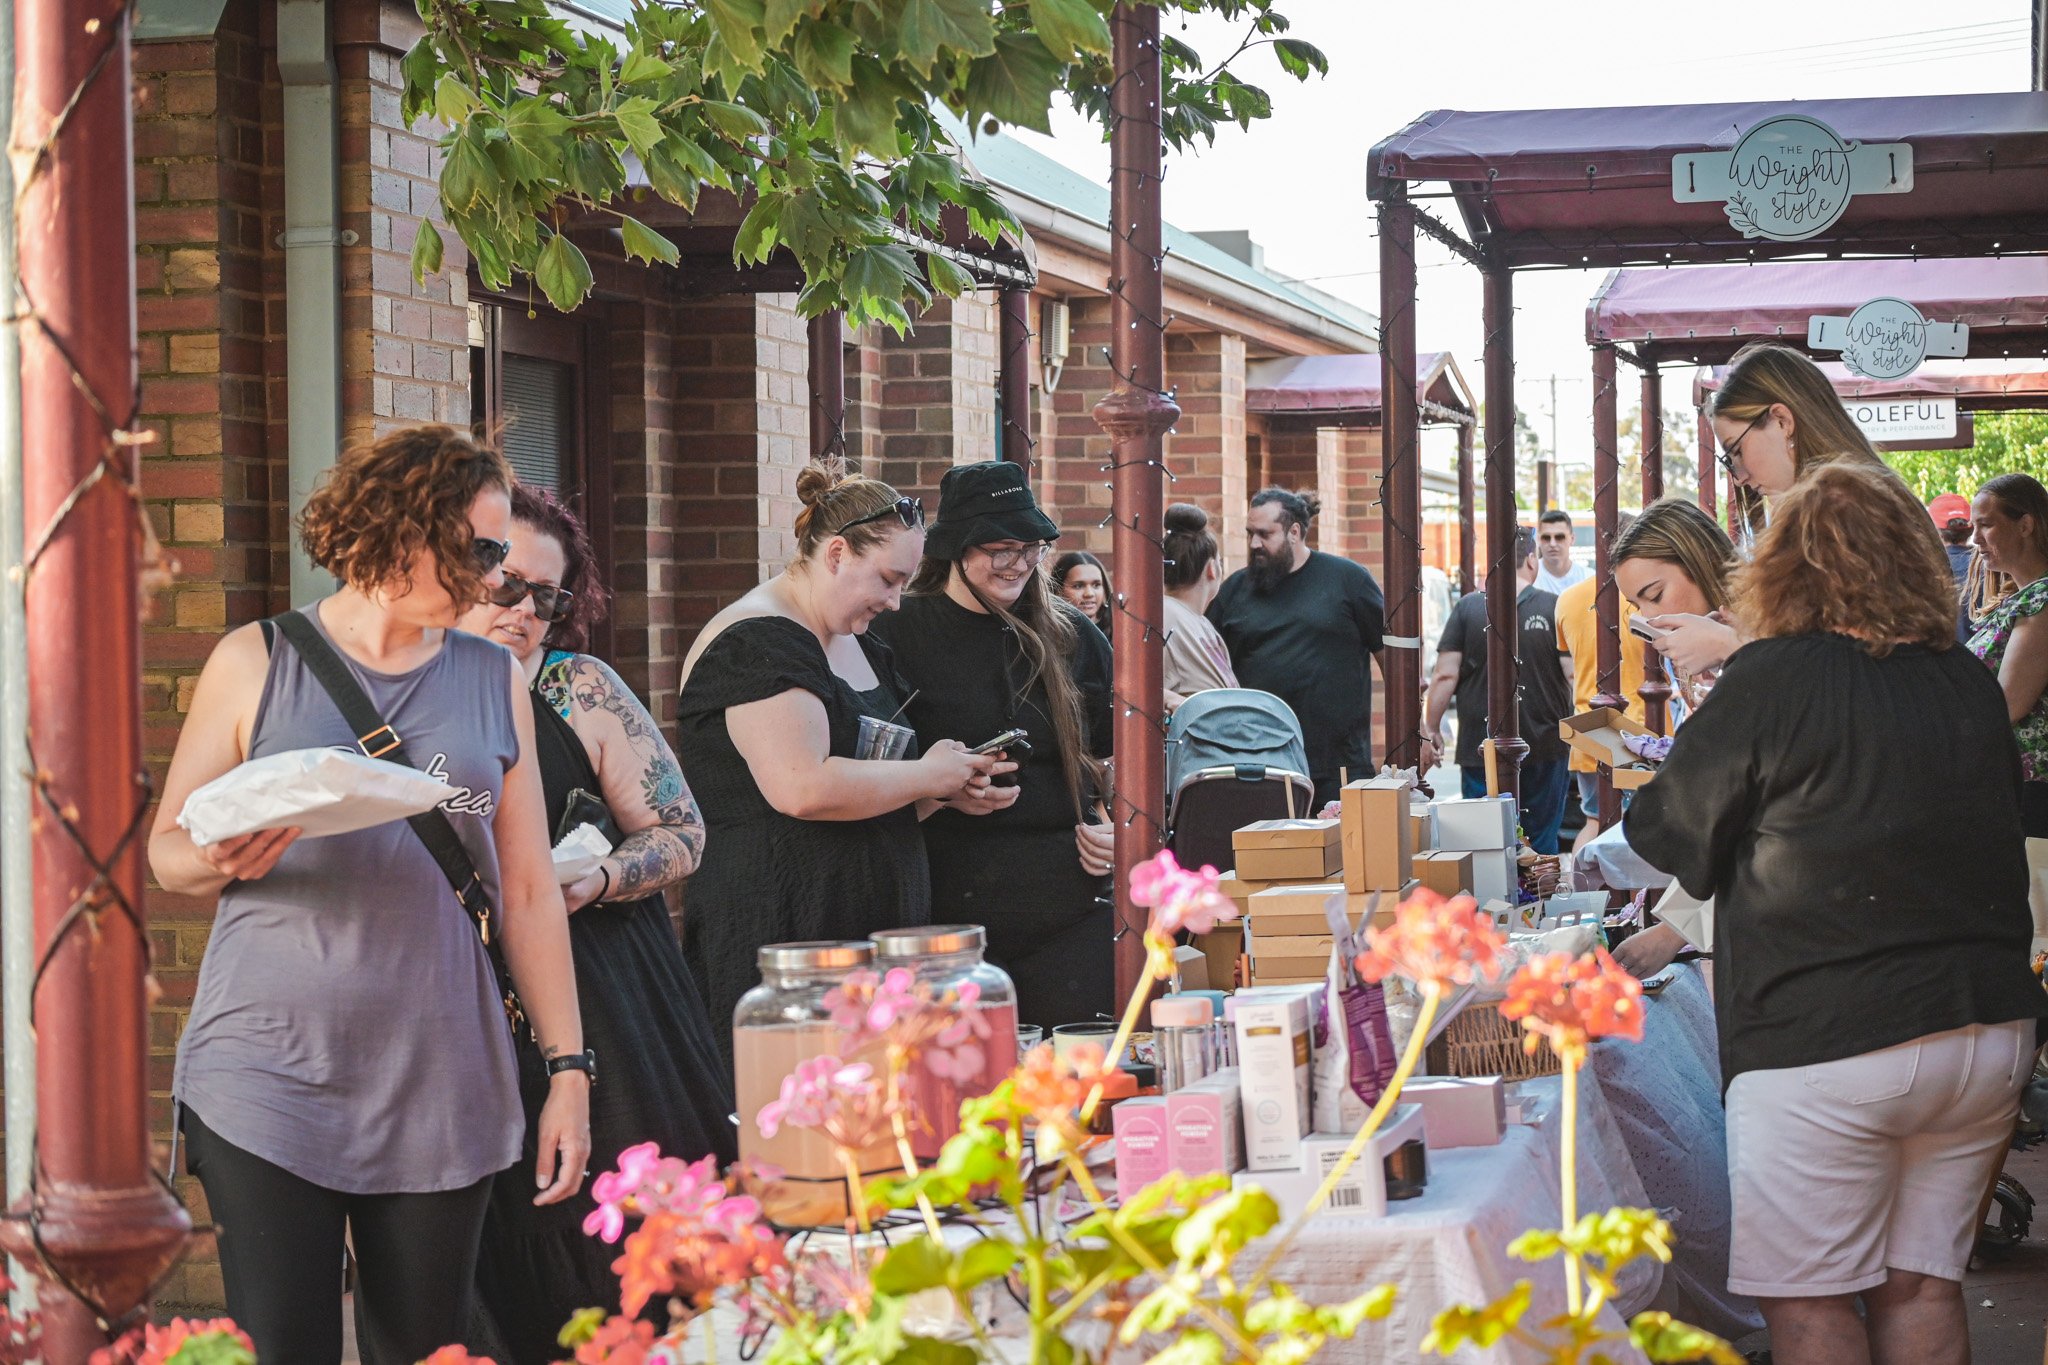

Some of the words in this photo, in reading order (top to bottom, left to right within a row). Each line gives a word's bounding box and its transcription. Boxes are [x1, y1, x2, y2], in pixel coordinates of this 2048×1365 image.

[1779, 145, 1803, 155] THE
[1729, 145, 1856, 194] Wright
[1881, 317, 1897, 325] THE
[1846, 321, 1932, 351] Wright
[1845, 404, 1946, 423] OLEFUL
[1889, 424, 1946, 433] PERFORMANCE
